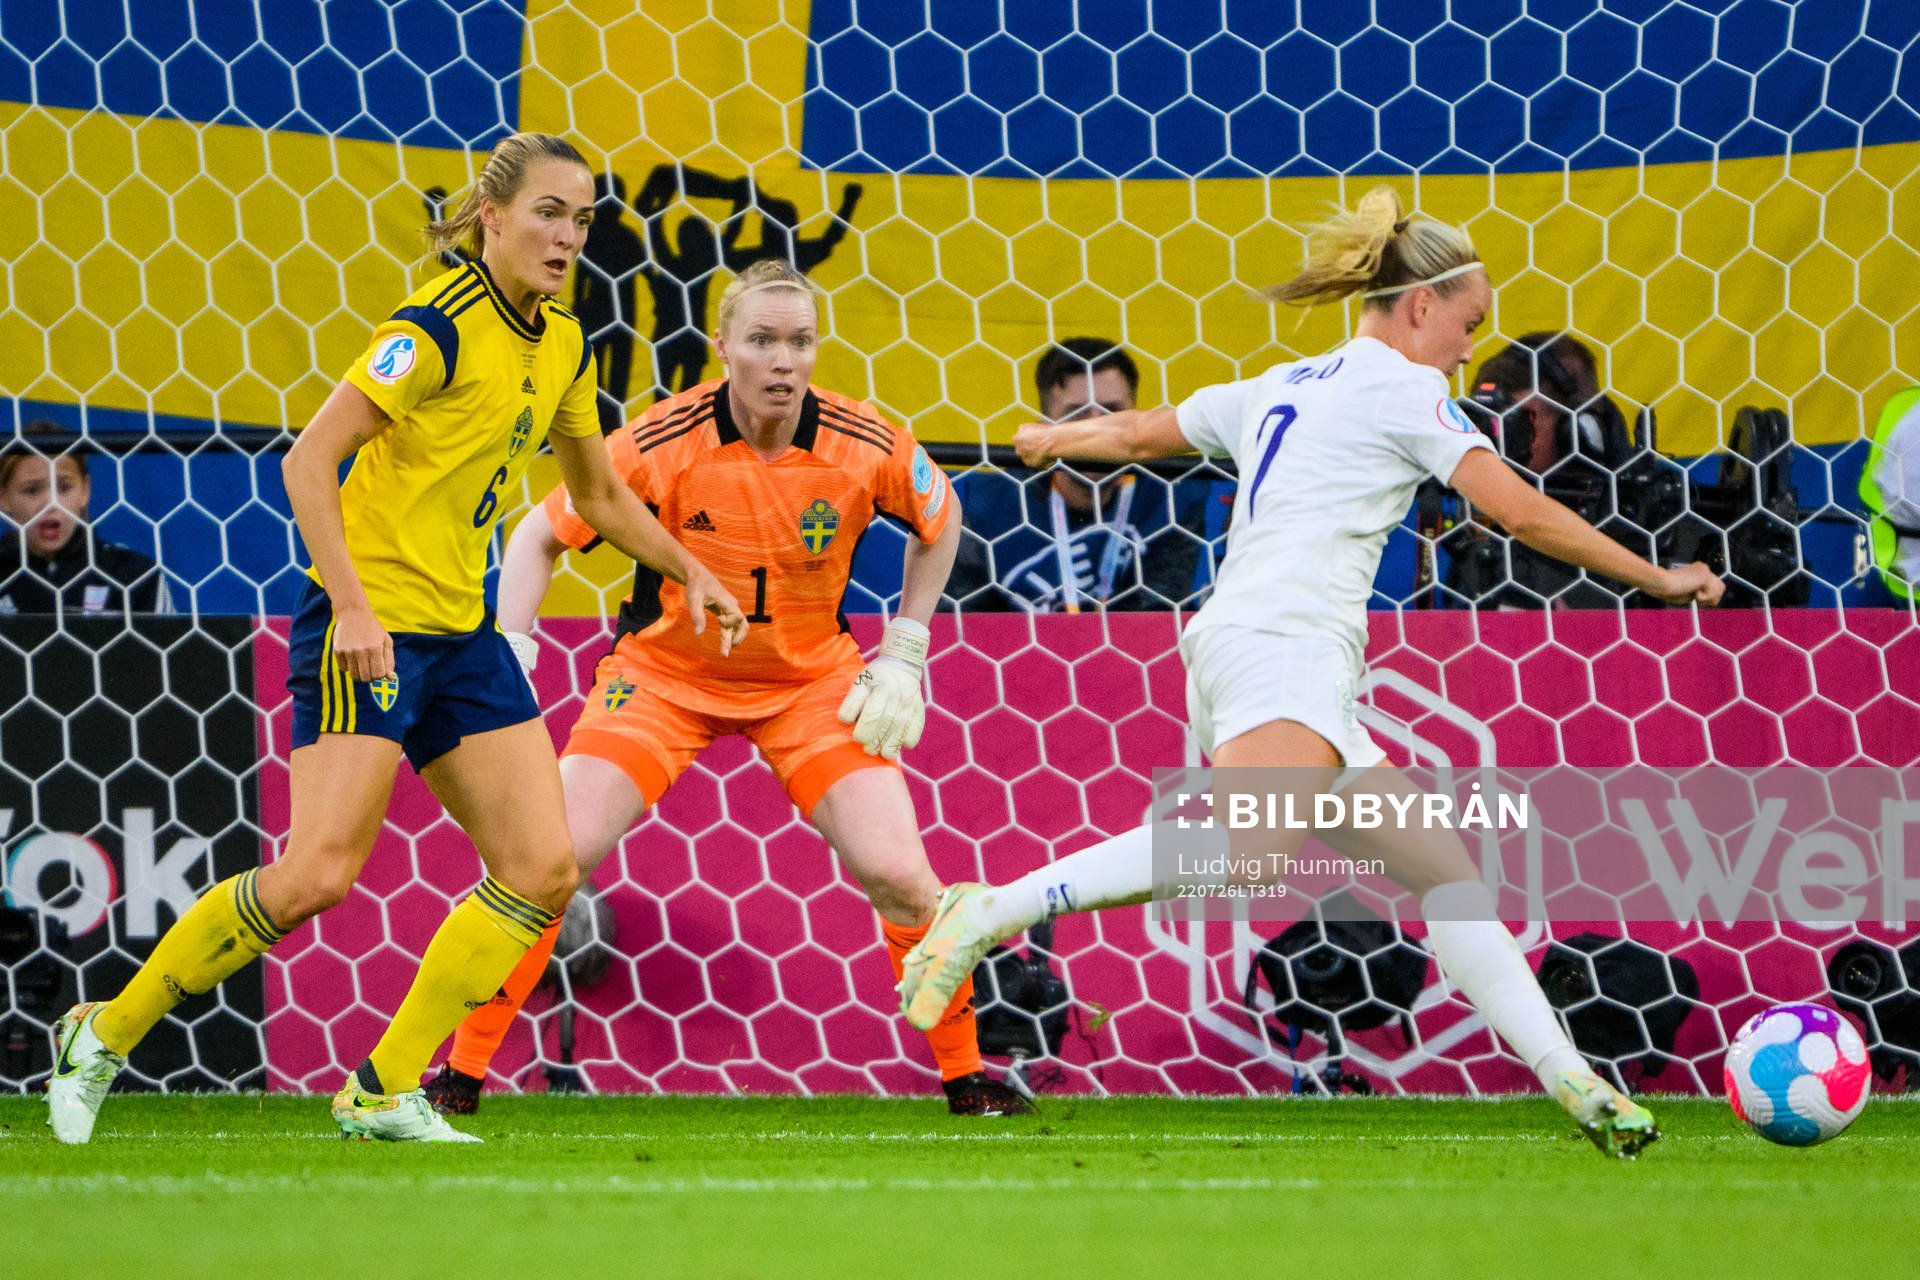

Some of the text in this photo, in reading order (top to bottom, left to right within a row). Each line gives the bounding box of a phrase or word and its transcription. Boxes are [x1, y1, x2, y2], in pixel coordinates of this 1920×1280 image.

[1249, 404, 1298, 525] 7
[473, 466, 507, 528] 6
[682, 522, 716, 532] adidas
[746, 566, 772, 623] 1
